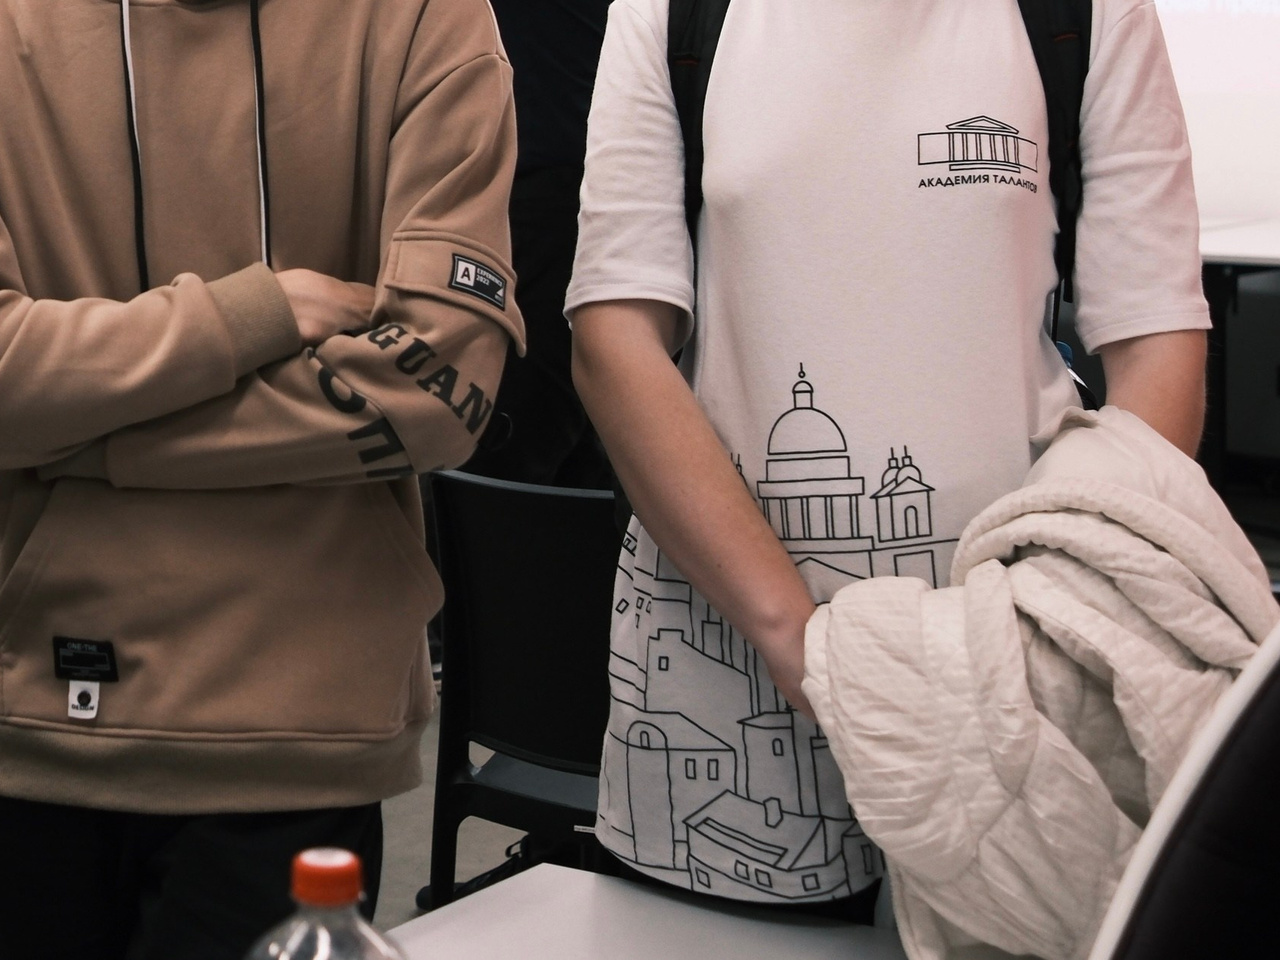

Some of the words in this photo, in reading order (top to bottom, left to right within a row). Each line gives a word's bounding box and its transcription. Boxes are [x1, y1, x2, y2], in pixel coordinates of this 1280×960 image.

[918, 174, 990, 188] АКАДЕМИЯ
[993, 174, 1038, 194] ТАЛАНТОВ
[460, 267, 472, 282] A
